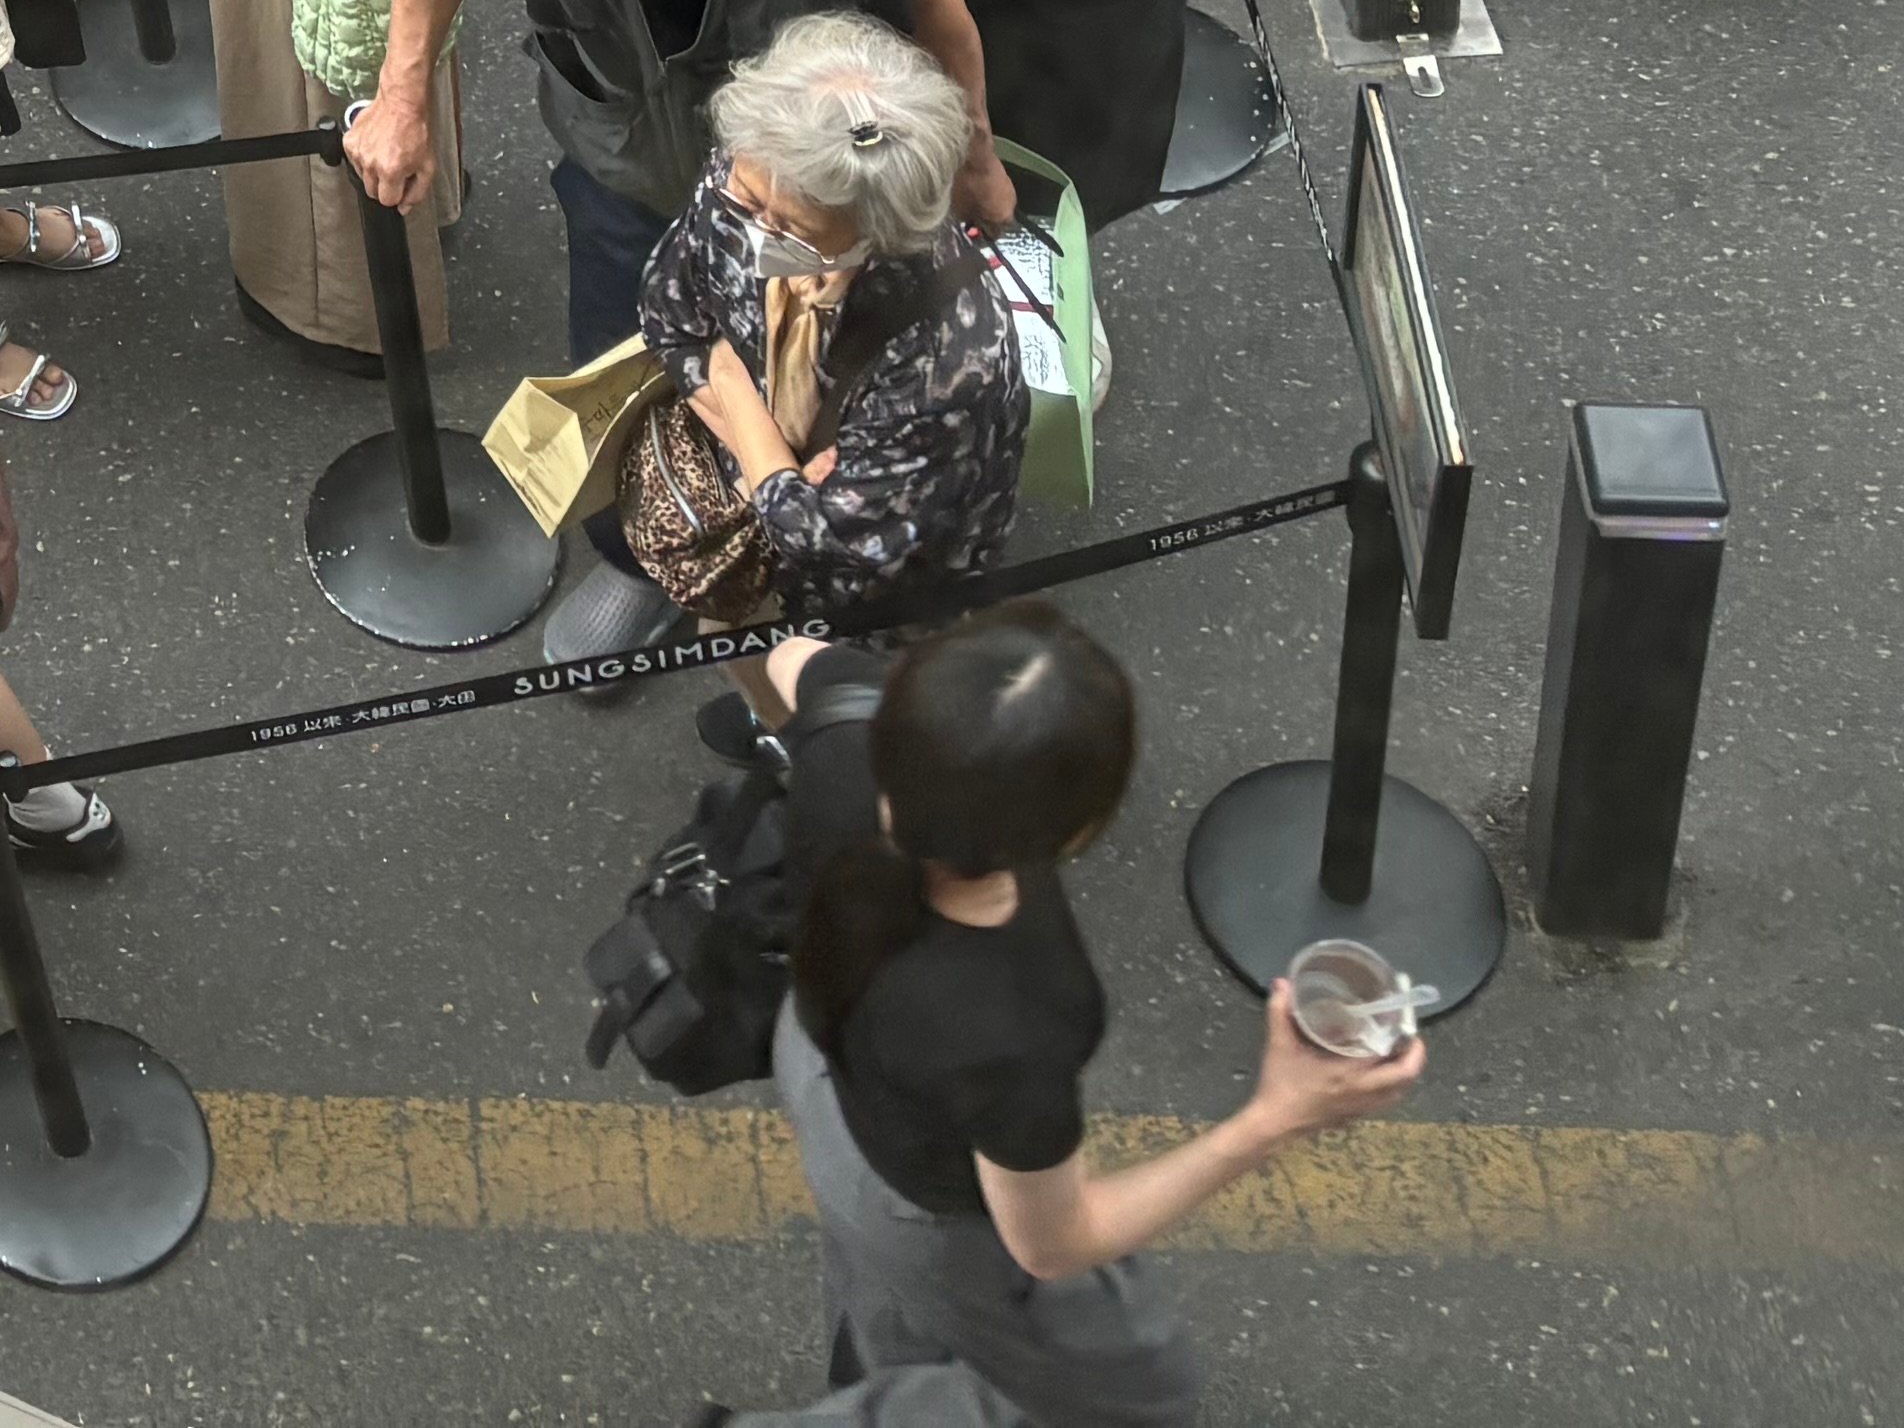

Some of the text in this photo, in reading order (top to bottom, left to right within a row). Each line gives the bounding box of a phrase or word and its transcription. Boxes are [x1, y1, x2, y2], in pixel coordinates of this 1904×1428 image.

[1149, 527, 1200, 551] 1956
[513, 619, 832, 696] SUNGSIMDANG
[249, 722, 298, 743] 1956
